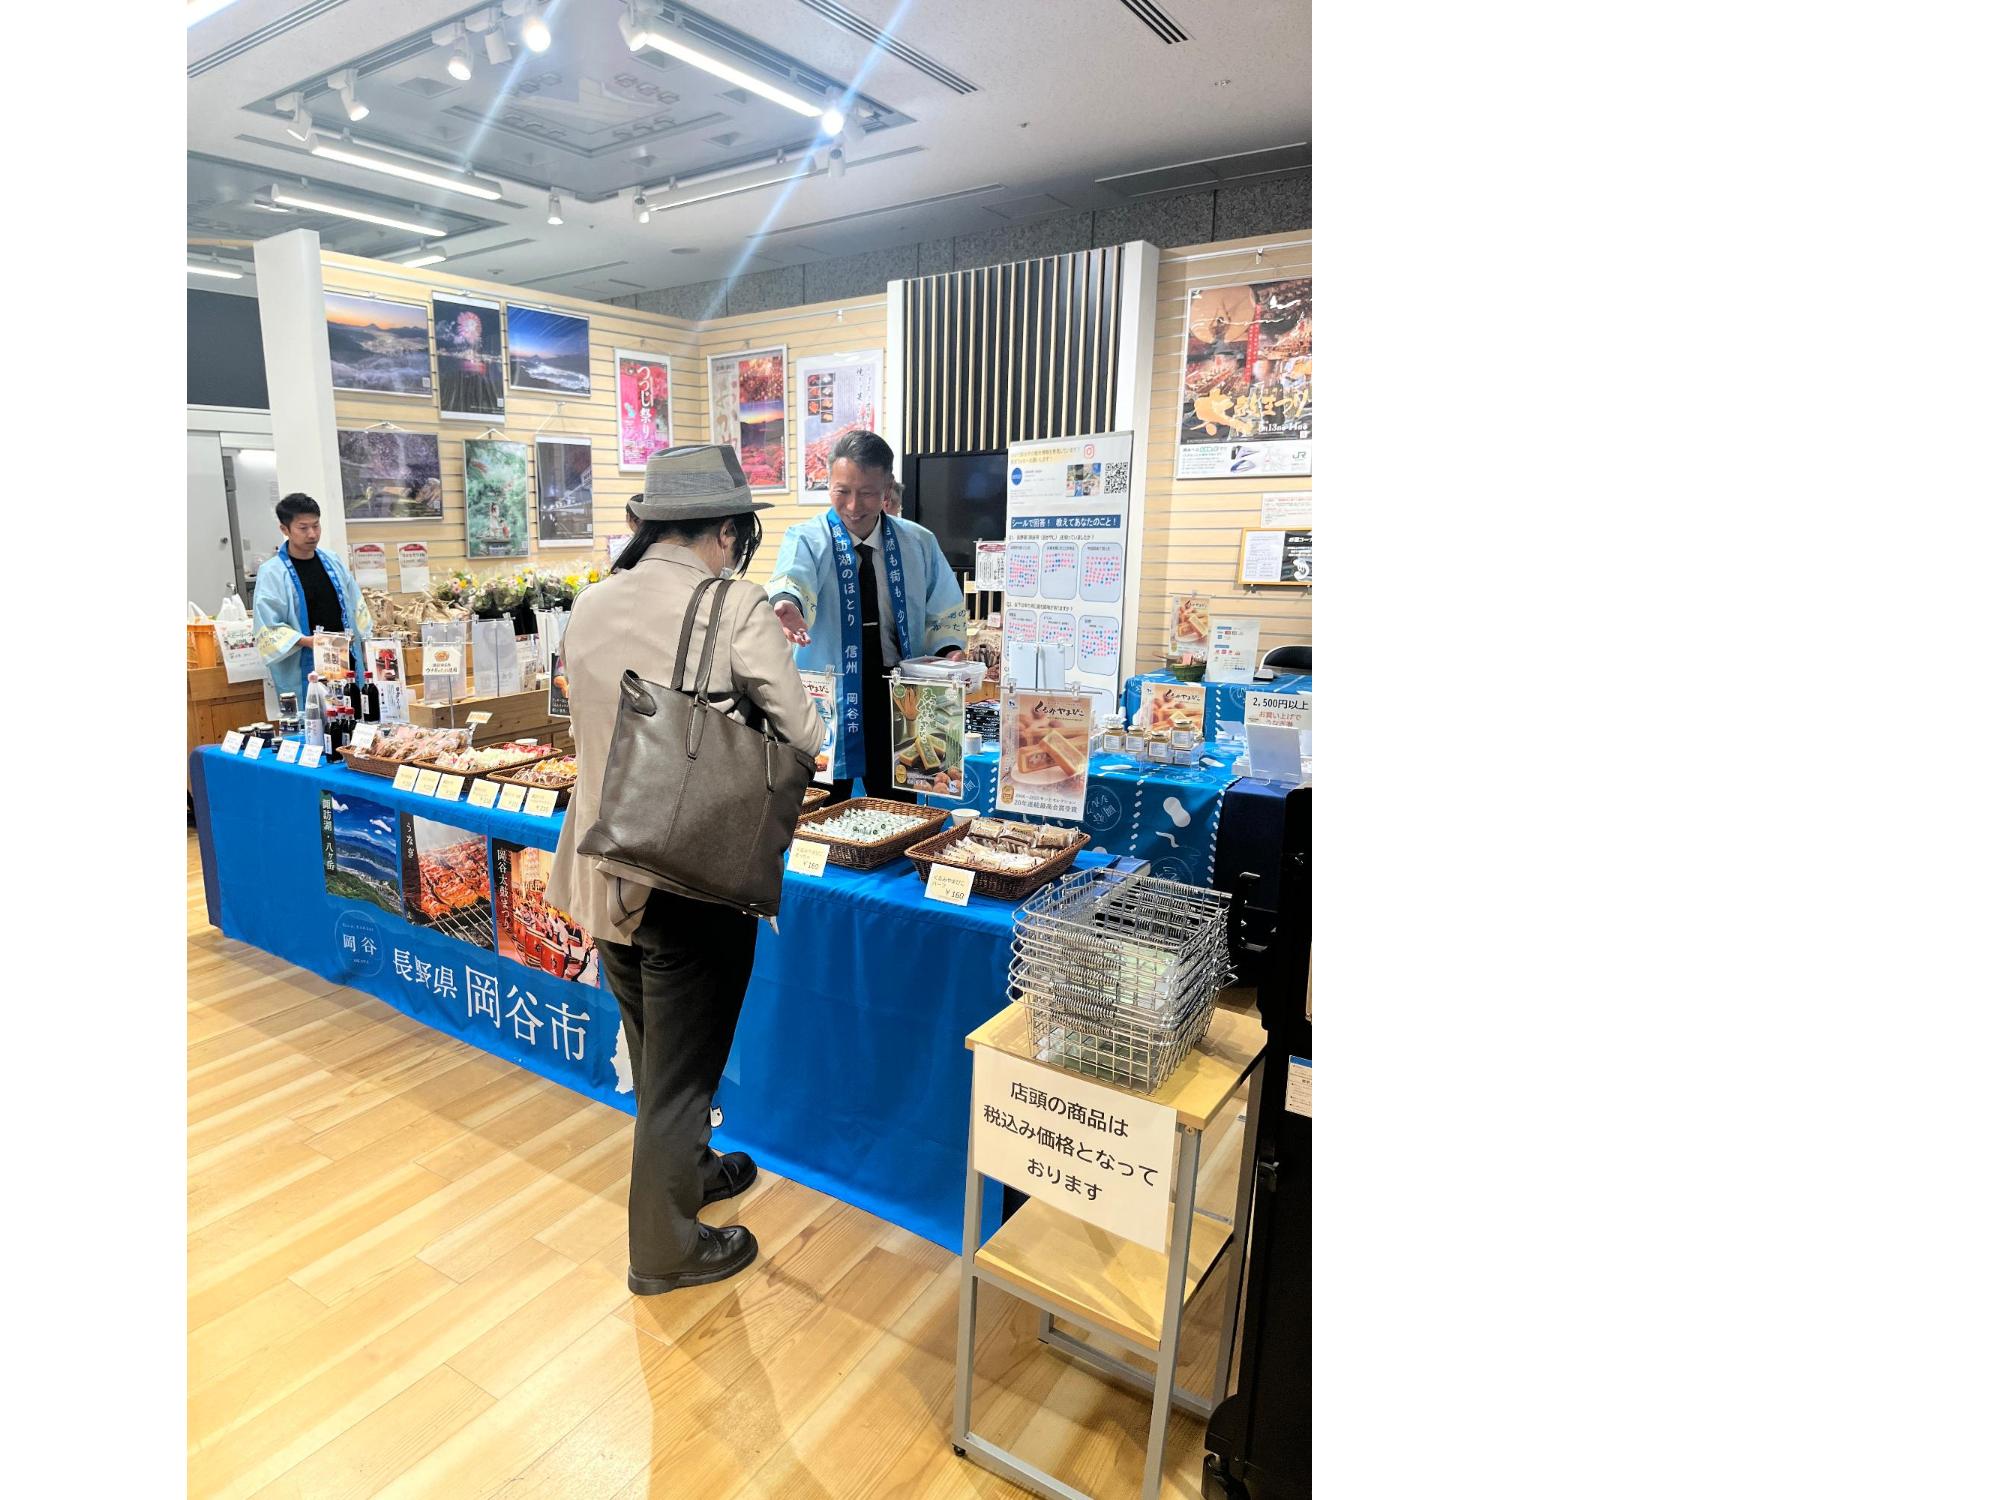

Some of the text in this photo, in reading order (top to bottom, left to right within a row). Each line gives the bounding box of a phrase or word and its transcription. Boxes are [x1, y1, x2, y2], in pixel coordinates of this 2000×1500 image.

[637, 366, 653, 439] つつじ祭り
[1056, 516, 1117, 528] 教えてあなたのこと！
[845, 644, 859, 674] 信州
[846, 692, 860, 734] 岡谷市
[1034, 700, 1085, 717] くるみやまびこ
[406, 822, 415, 859] うなぎ
[497, 848, 510, 930] 岡谷太鼓まつり
[343, 934, 377, 956] 岡谷
[392, 947, 591, 1061] 長野県 岡谷市
[1010, 1081, 1130, 1139] 店頭の商品は
[983, 1103, 1160, 1187] 税込み価格となって
[1026, 1157, 1104, 1202] おります
